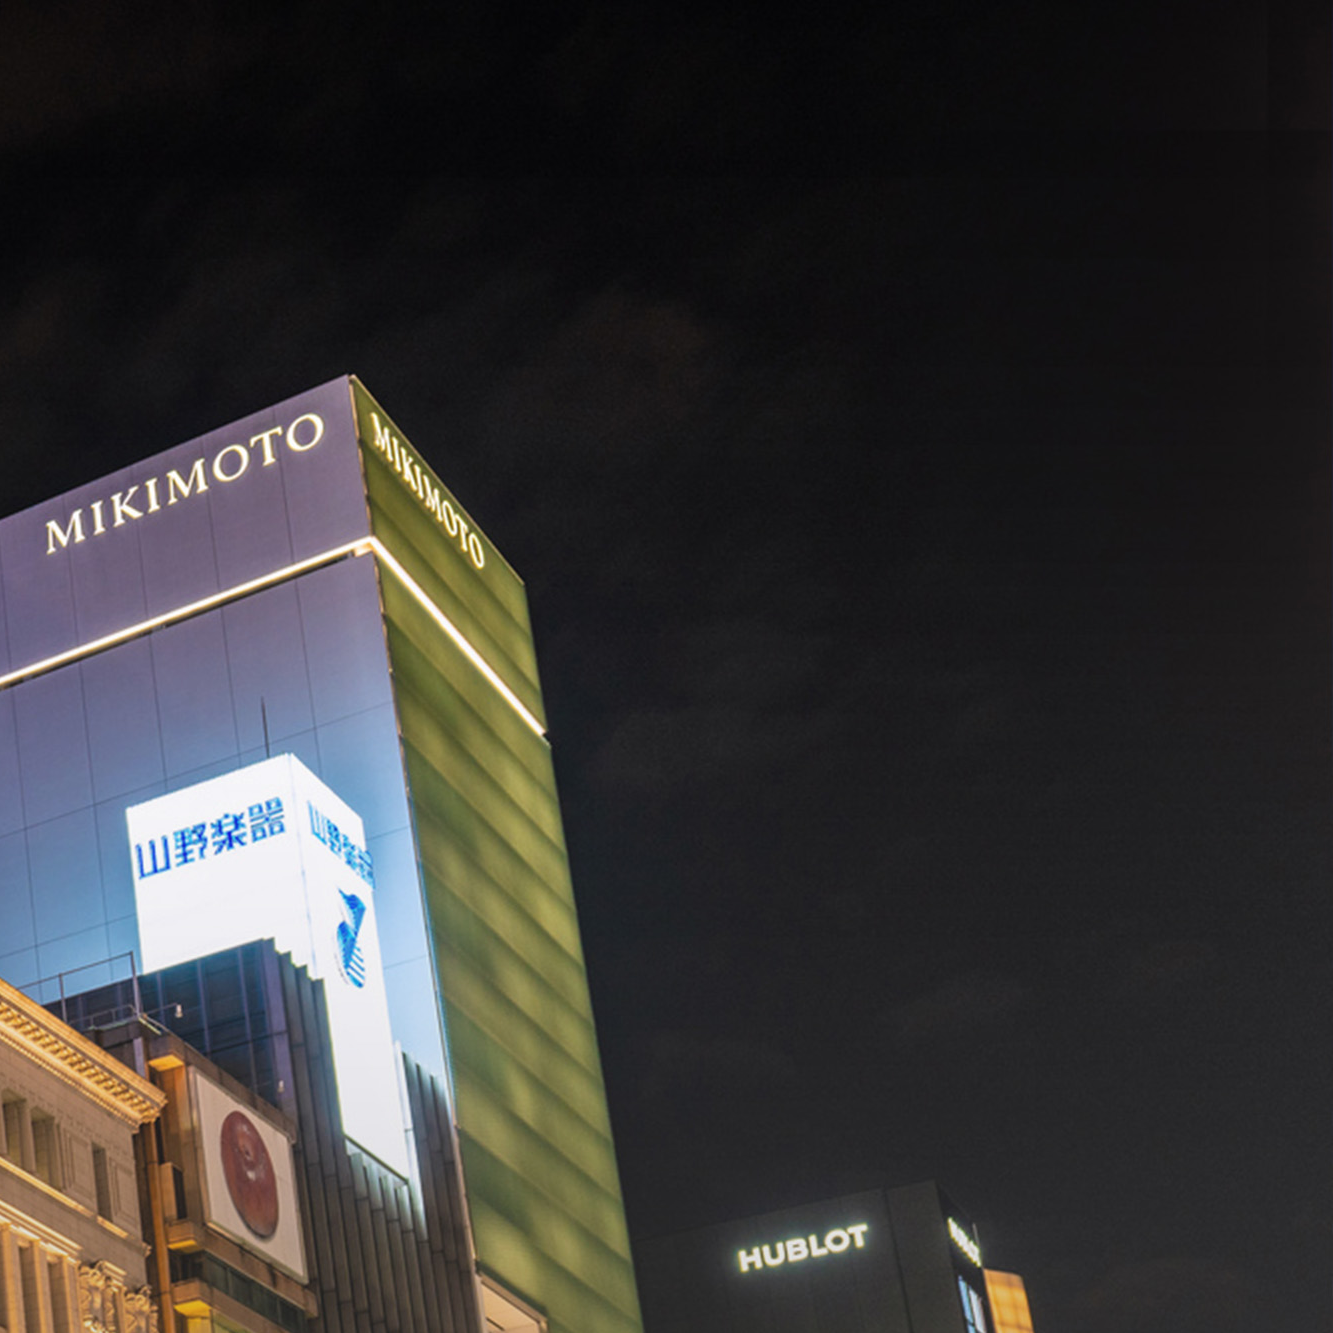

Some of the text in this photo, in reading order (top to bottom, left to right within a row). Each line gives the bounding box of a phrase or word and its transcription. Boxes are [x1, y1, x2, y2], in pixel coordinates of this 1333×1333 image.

[44, 412, 326, 555] MIKIMOTO
[370, 411, 486, 570] MIKIMOTO
[134, 795, 286, 881] 山野楽器
[737, 1223, 869, 1274] HUBLOT
